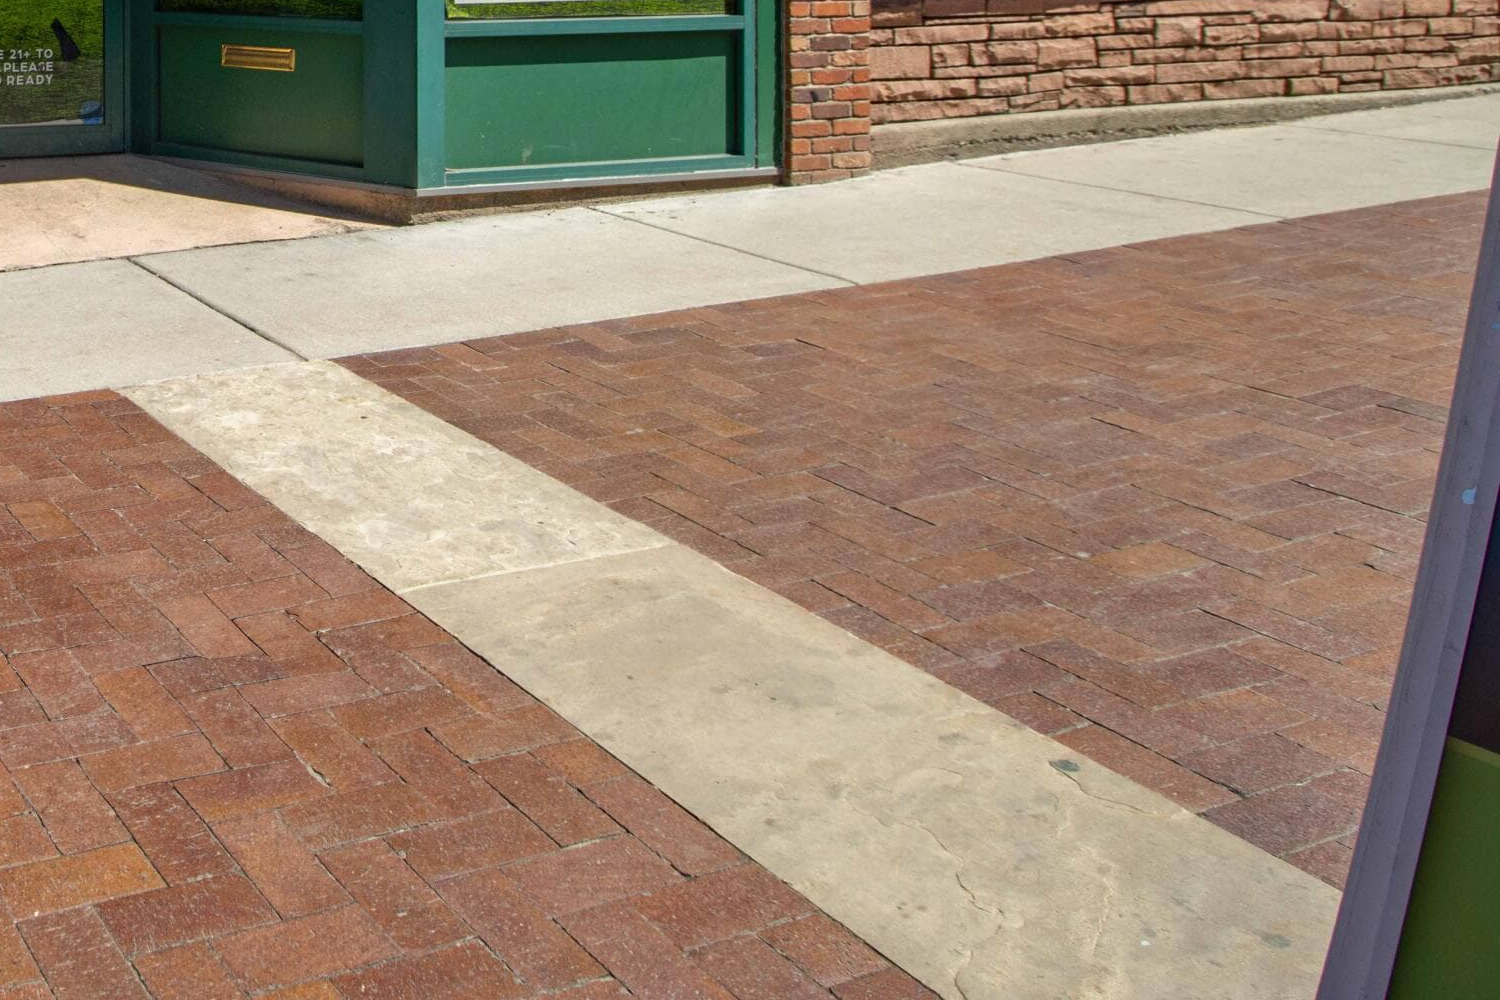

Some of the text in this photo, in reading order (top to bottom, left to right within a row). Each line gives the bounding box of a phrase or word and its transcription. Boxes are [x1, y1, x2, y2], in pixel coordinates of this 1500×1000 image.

[9, 49, 31, 60] 21+
[35, 48, 54, 59] TO
[6, 74, 54, 86] READY
